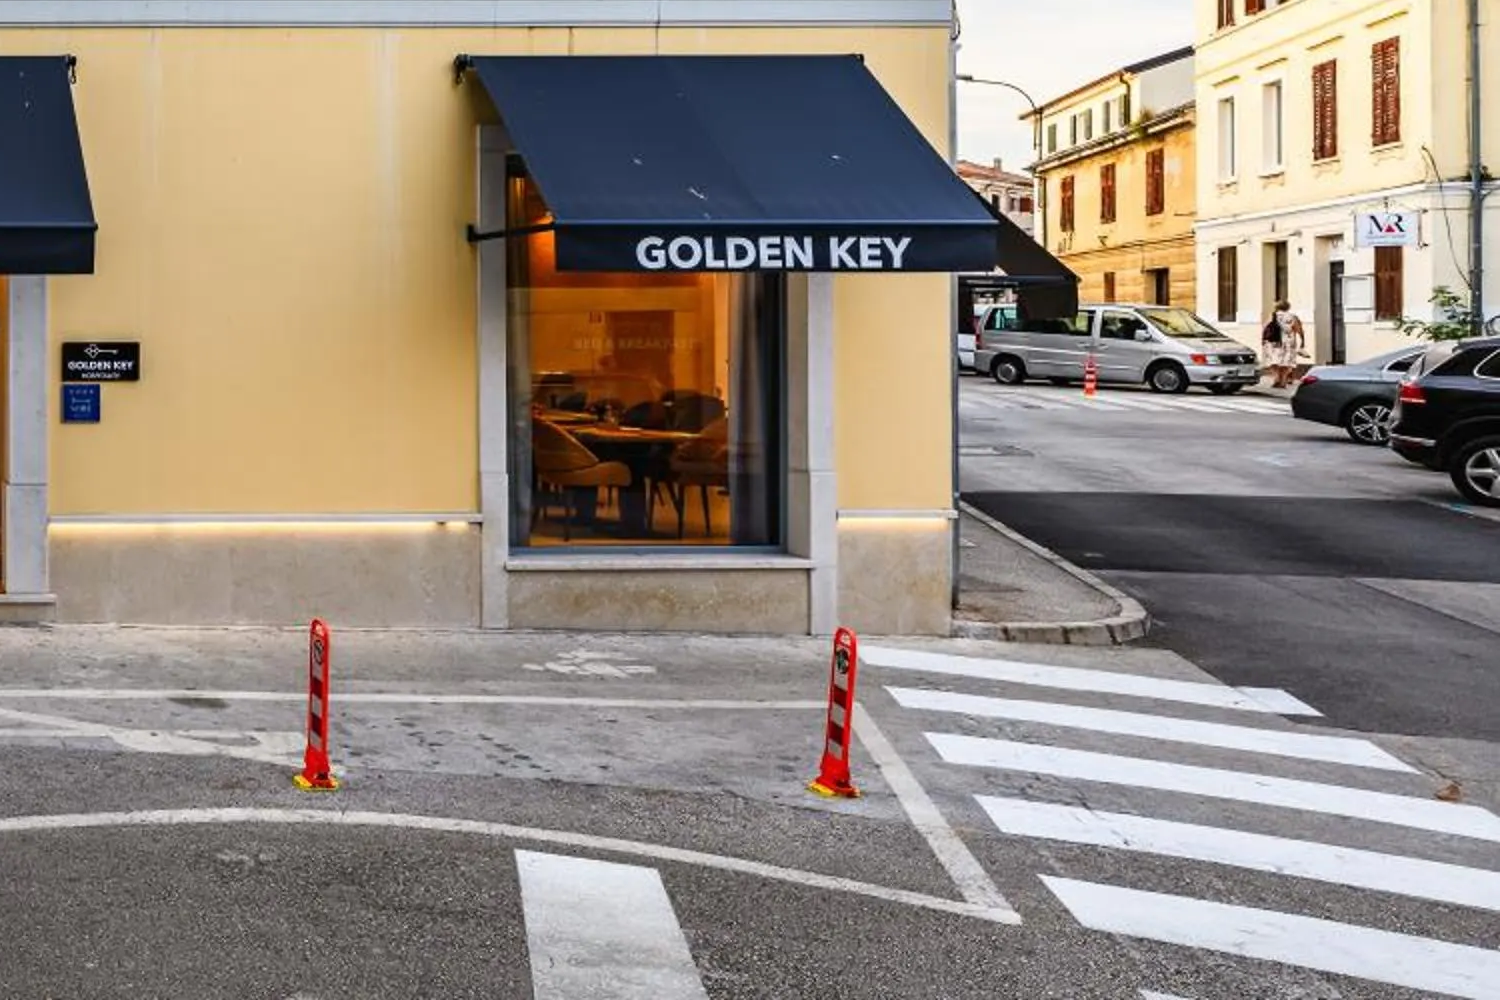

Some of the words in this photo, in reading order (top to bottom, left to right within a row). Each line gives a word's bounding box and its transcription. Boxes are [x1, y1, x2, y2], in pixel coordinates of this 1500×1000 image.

[636, 236, 813, 269] GOLDEN
[830, 237, 912, 269] KEY
[68, 361, 111, 370] GOLDEN
[113, 361, 133, 370] KEY
